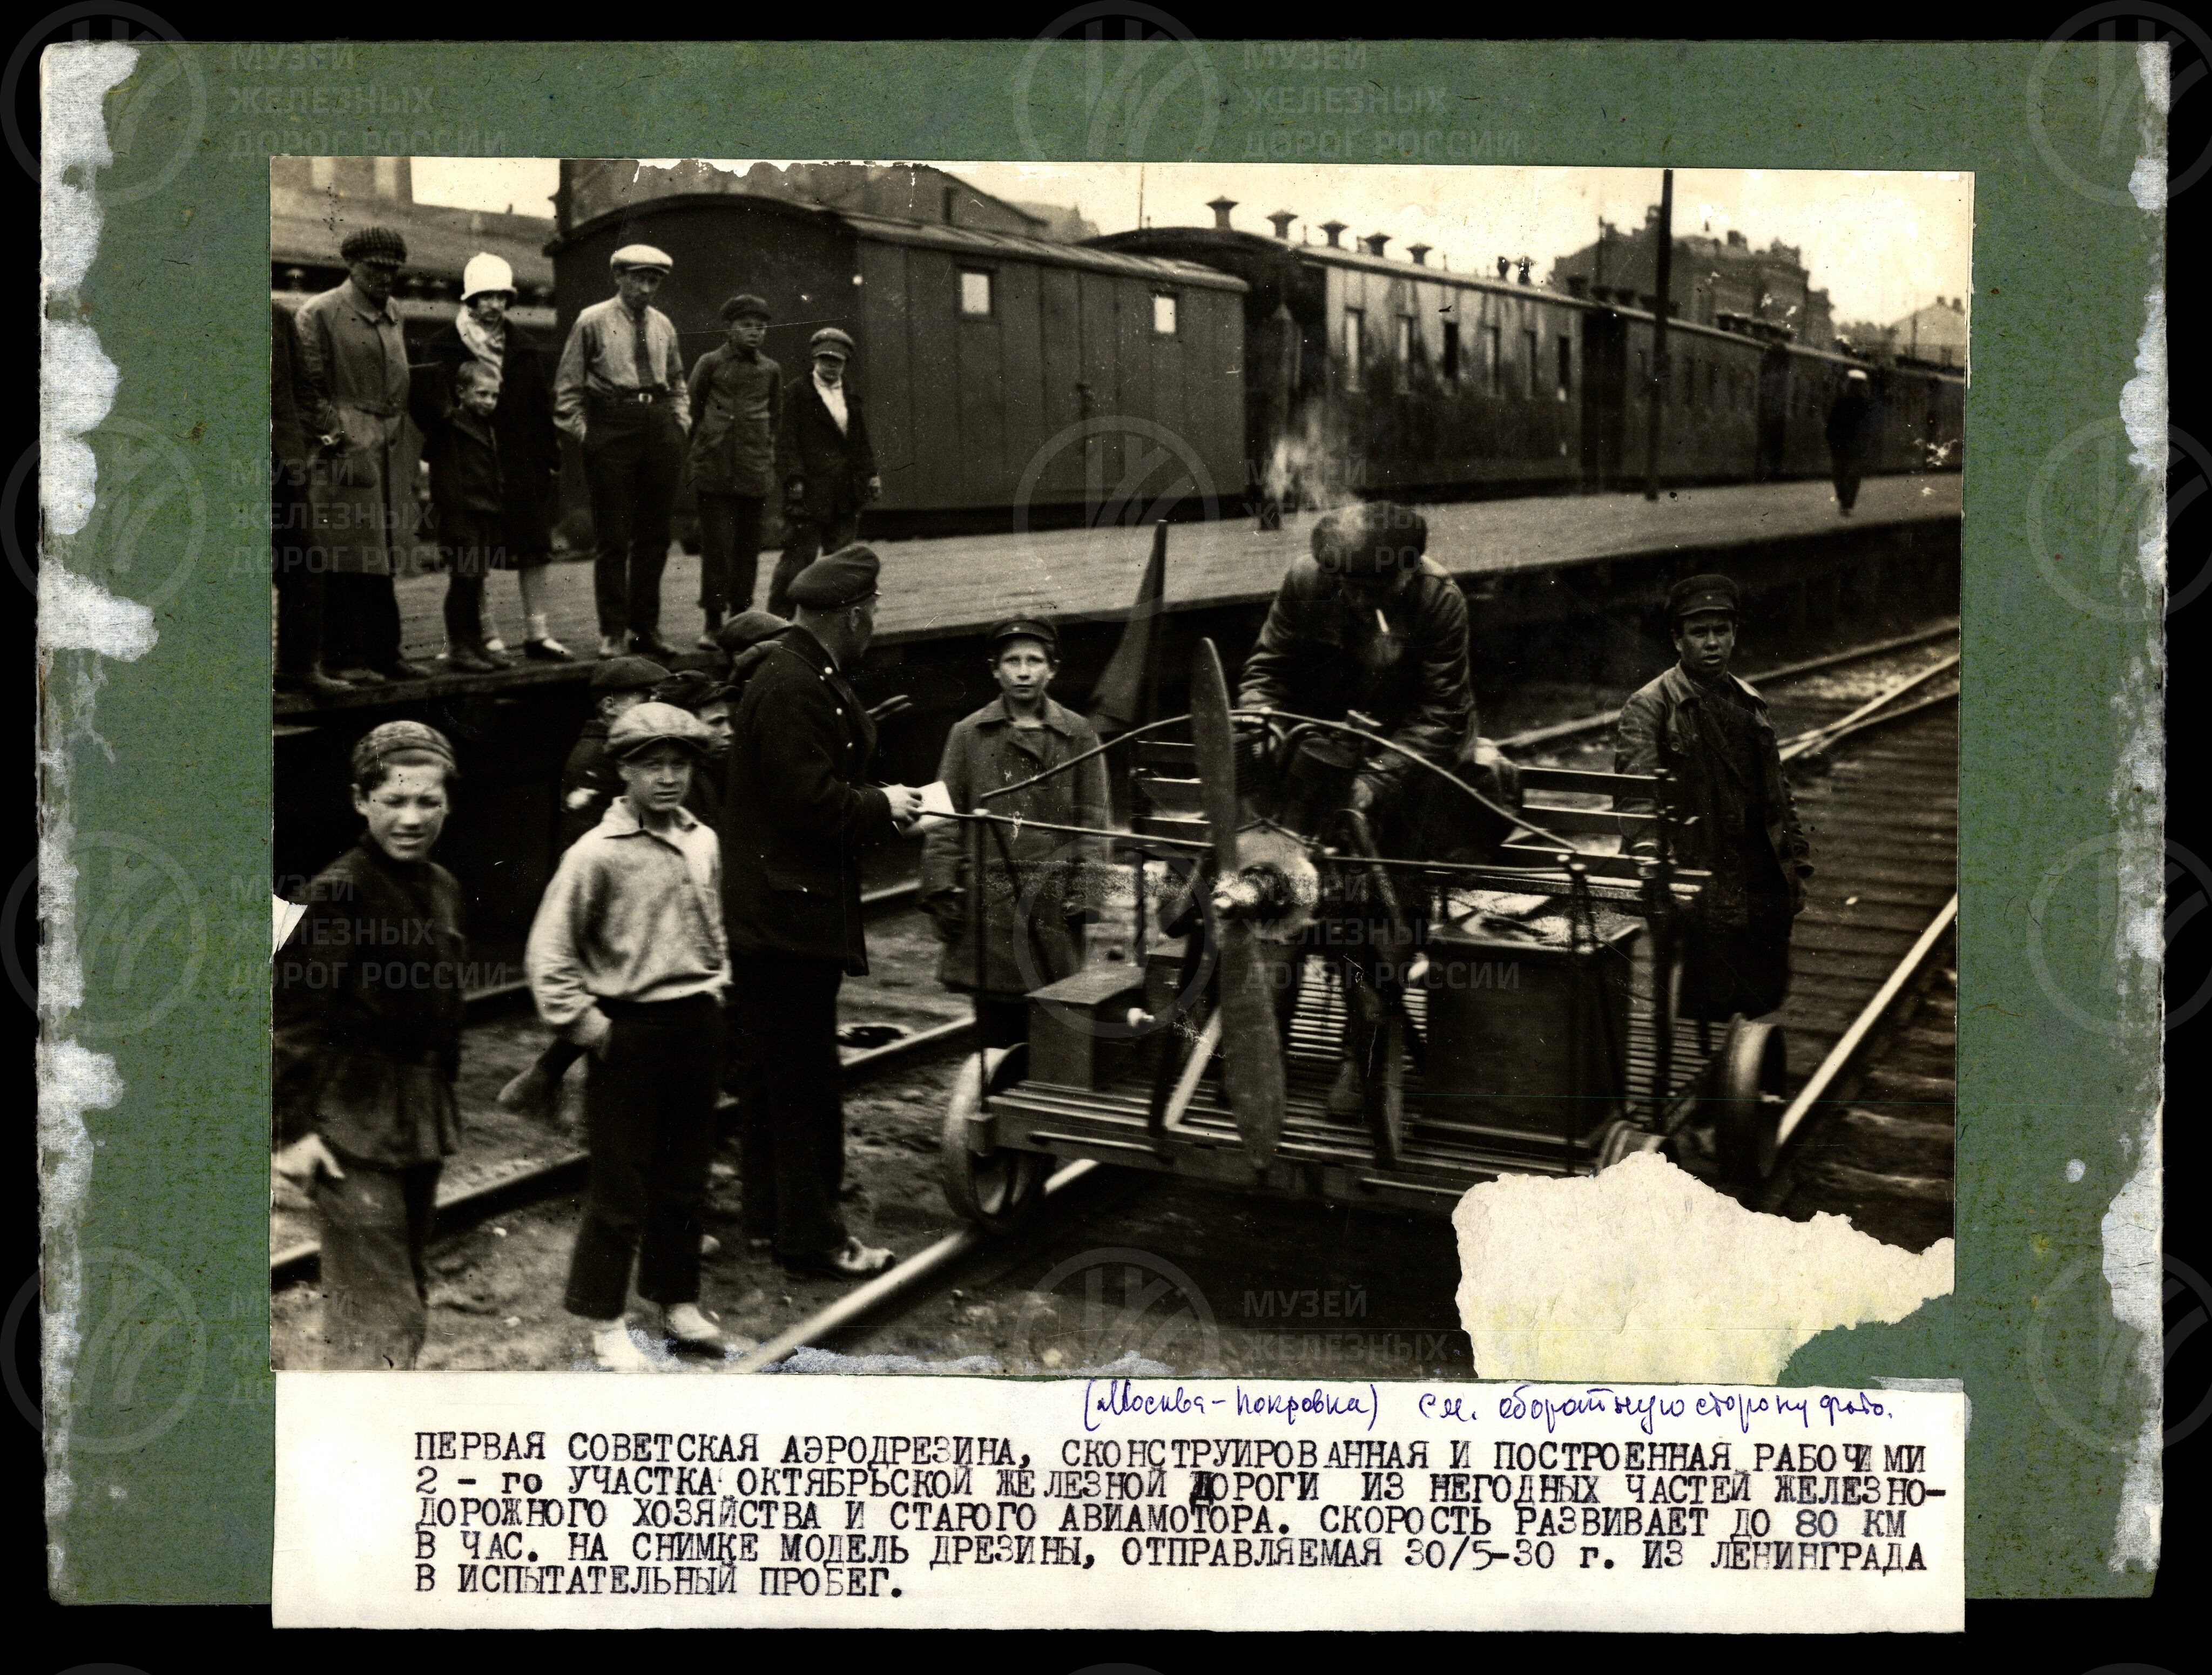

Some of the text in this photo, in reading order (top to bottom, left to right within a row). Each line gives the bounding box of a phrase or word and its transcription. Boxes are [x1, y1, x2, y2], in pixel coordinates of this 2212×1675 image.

[1499, 1384, 1685, 1434] оборотную
[1696, 1393, 1808, 1433] сторону
[415, 1431, 545, 1460] ПЕРВАЯ
[569, 1433, 758, 1462] СОВЕТСКАЯ
[780, 1435, 1033, 1469] АЭРОДРЕЗИНА,
[1449, 1440, 1471, 1469] И
[1494, 1441, 1731, 1471] ПОСТРОЕННАЯ
[416, 1466, 437, 1494] 2
[502, 1473, 542, 1494] го
[569, 1467, 716, 1495] УЧАСТКА
[737, 1463, 972, 1498] ОКТЯБРЬСКОЙ
[994, 1463, 1166, 1499] ЖЕЛЕЗНОЙ
[1189, 1471, 1319, 1508] ДОРОГИ
[1361, 1472, 1404, 1501] ИЗ
[1429, 1473, 1600, 1508] НЕГОДНЫХ
[1624, 1467, 1751, 1504] ЧАСТЕЙ
[1775, 1475, 1946, 1505] ЖЕЛЕЗНО-
[415, 1493, 1906, 1545] ДОРОЖНОГО ХОЗЯЙСТВА И СТАРОГО АВИАМОТОРА. СКОРОСТЬ РАЗВИВАЕТ ДО 80 КМ
[415, 1531, 1926, 1576] В ЧАС. НА СНИМКЕ МОДЕЛЬ ДРЕЗИНЫ, ОТПРАВЛЯЕМАЯ 30/5-30 г. ИЗ ЛЕНИНГРАДА
[415, 1559, 901, 1597] В ИСПЫТАТЕЛЬНЫЙ ПРОБЕГ.
